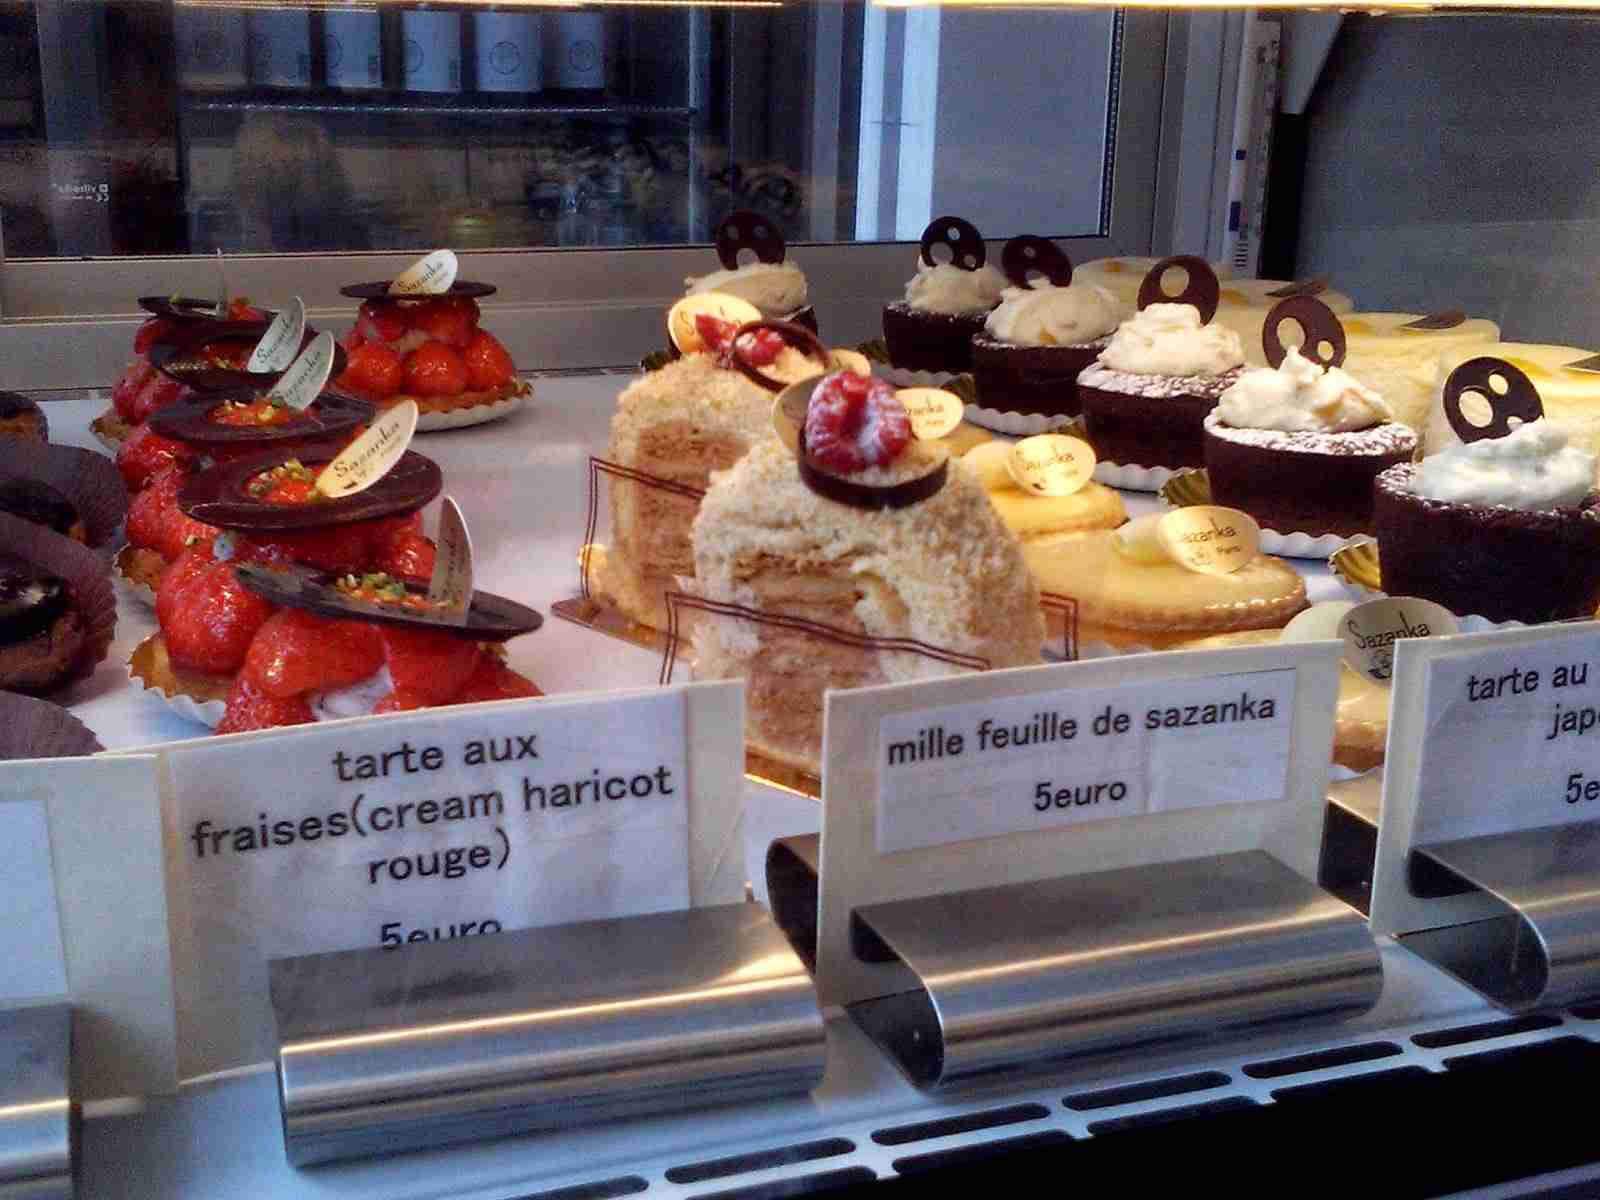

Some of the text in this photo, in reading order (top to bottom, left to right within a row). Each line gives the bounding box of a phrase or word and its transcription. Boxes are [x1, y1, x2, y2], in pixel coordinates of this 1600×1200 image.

[334, 421, 401, 478] Sazanka
[1346, 609, 1432, 649] Sazanka
[1467, 662, 1588, 701] tarte au
[887, 692, 1275, 766] mille feuille de sazanka
[1545, 703, 1600, 740] jap
[332, 735, 538, 781] tarte aux
[522, 765, 673, 812] haricot
[1034, 781, 1127, 811] 5euro
[368, 827, 510, 884] rouge)
